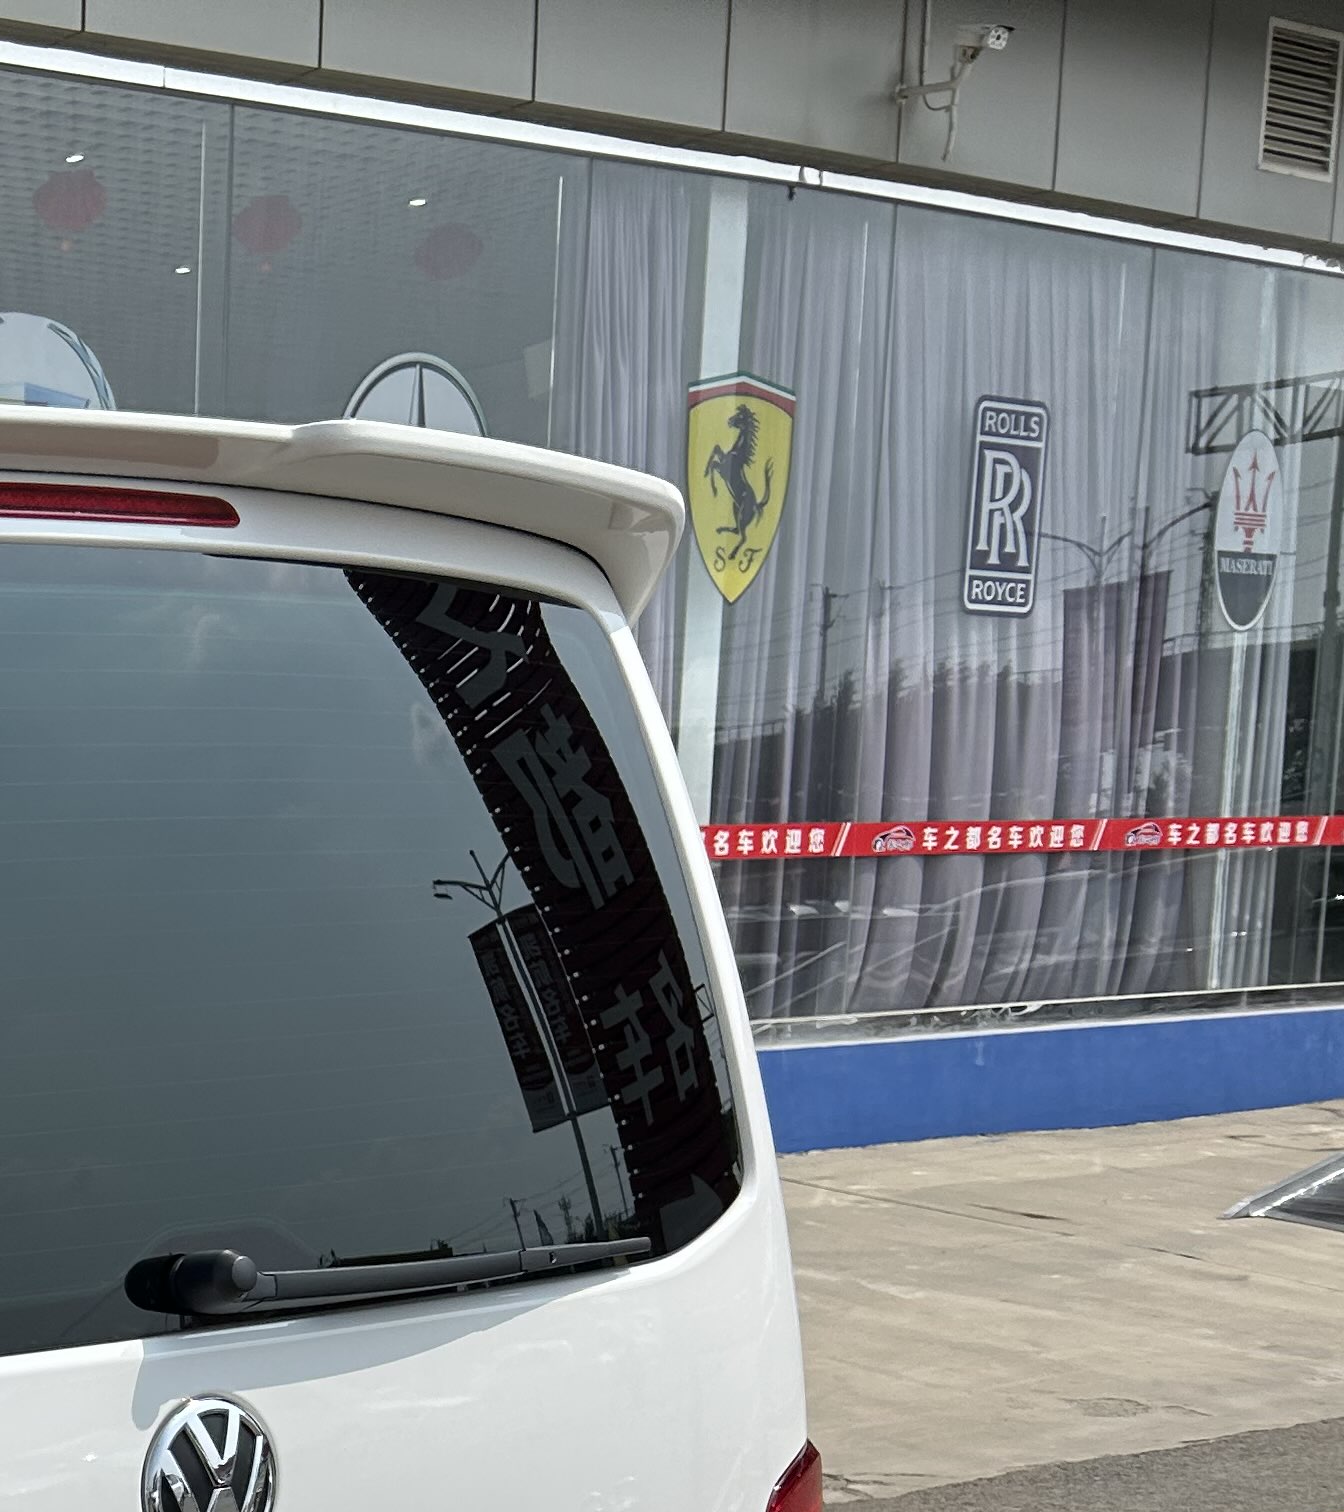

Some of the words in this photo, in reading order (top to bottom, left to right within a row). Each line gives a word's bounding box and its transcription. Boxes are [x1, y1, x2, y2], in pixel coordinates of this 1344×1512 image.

[984, 410, 1041, 438] ROLLS
[714, 546, 726, 573] S
[971, 579, 1027, 604] ROYCE
[700, 828, 826, 857] 名车欢迎您
